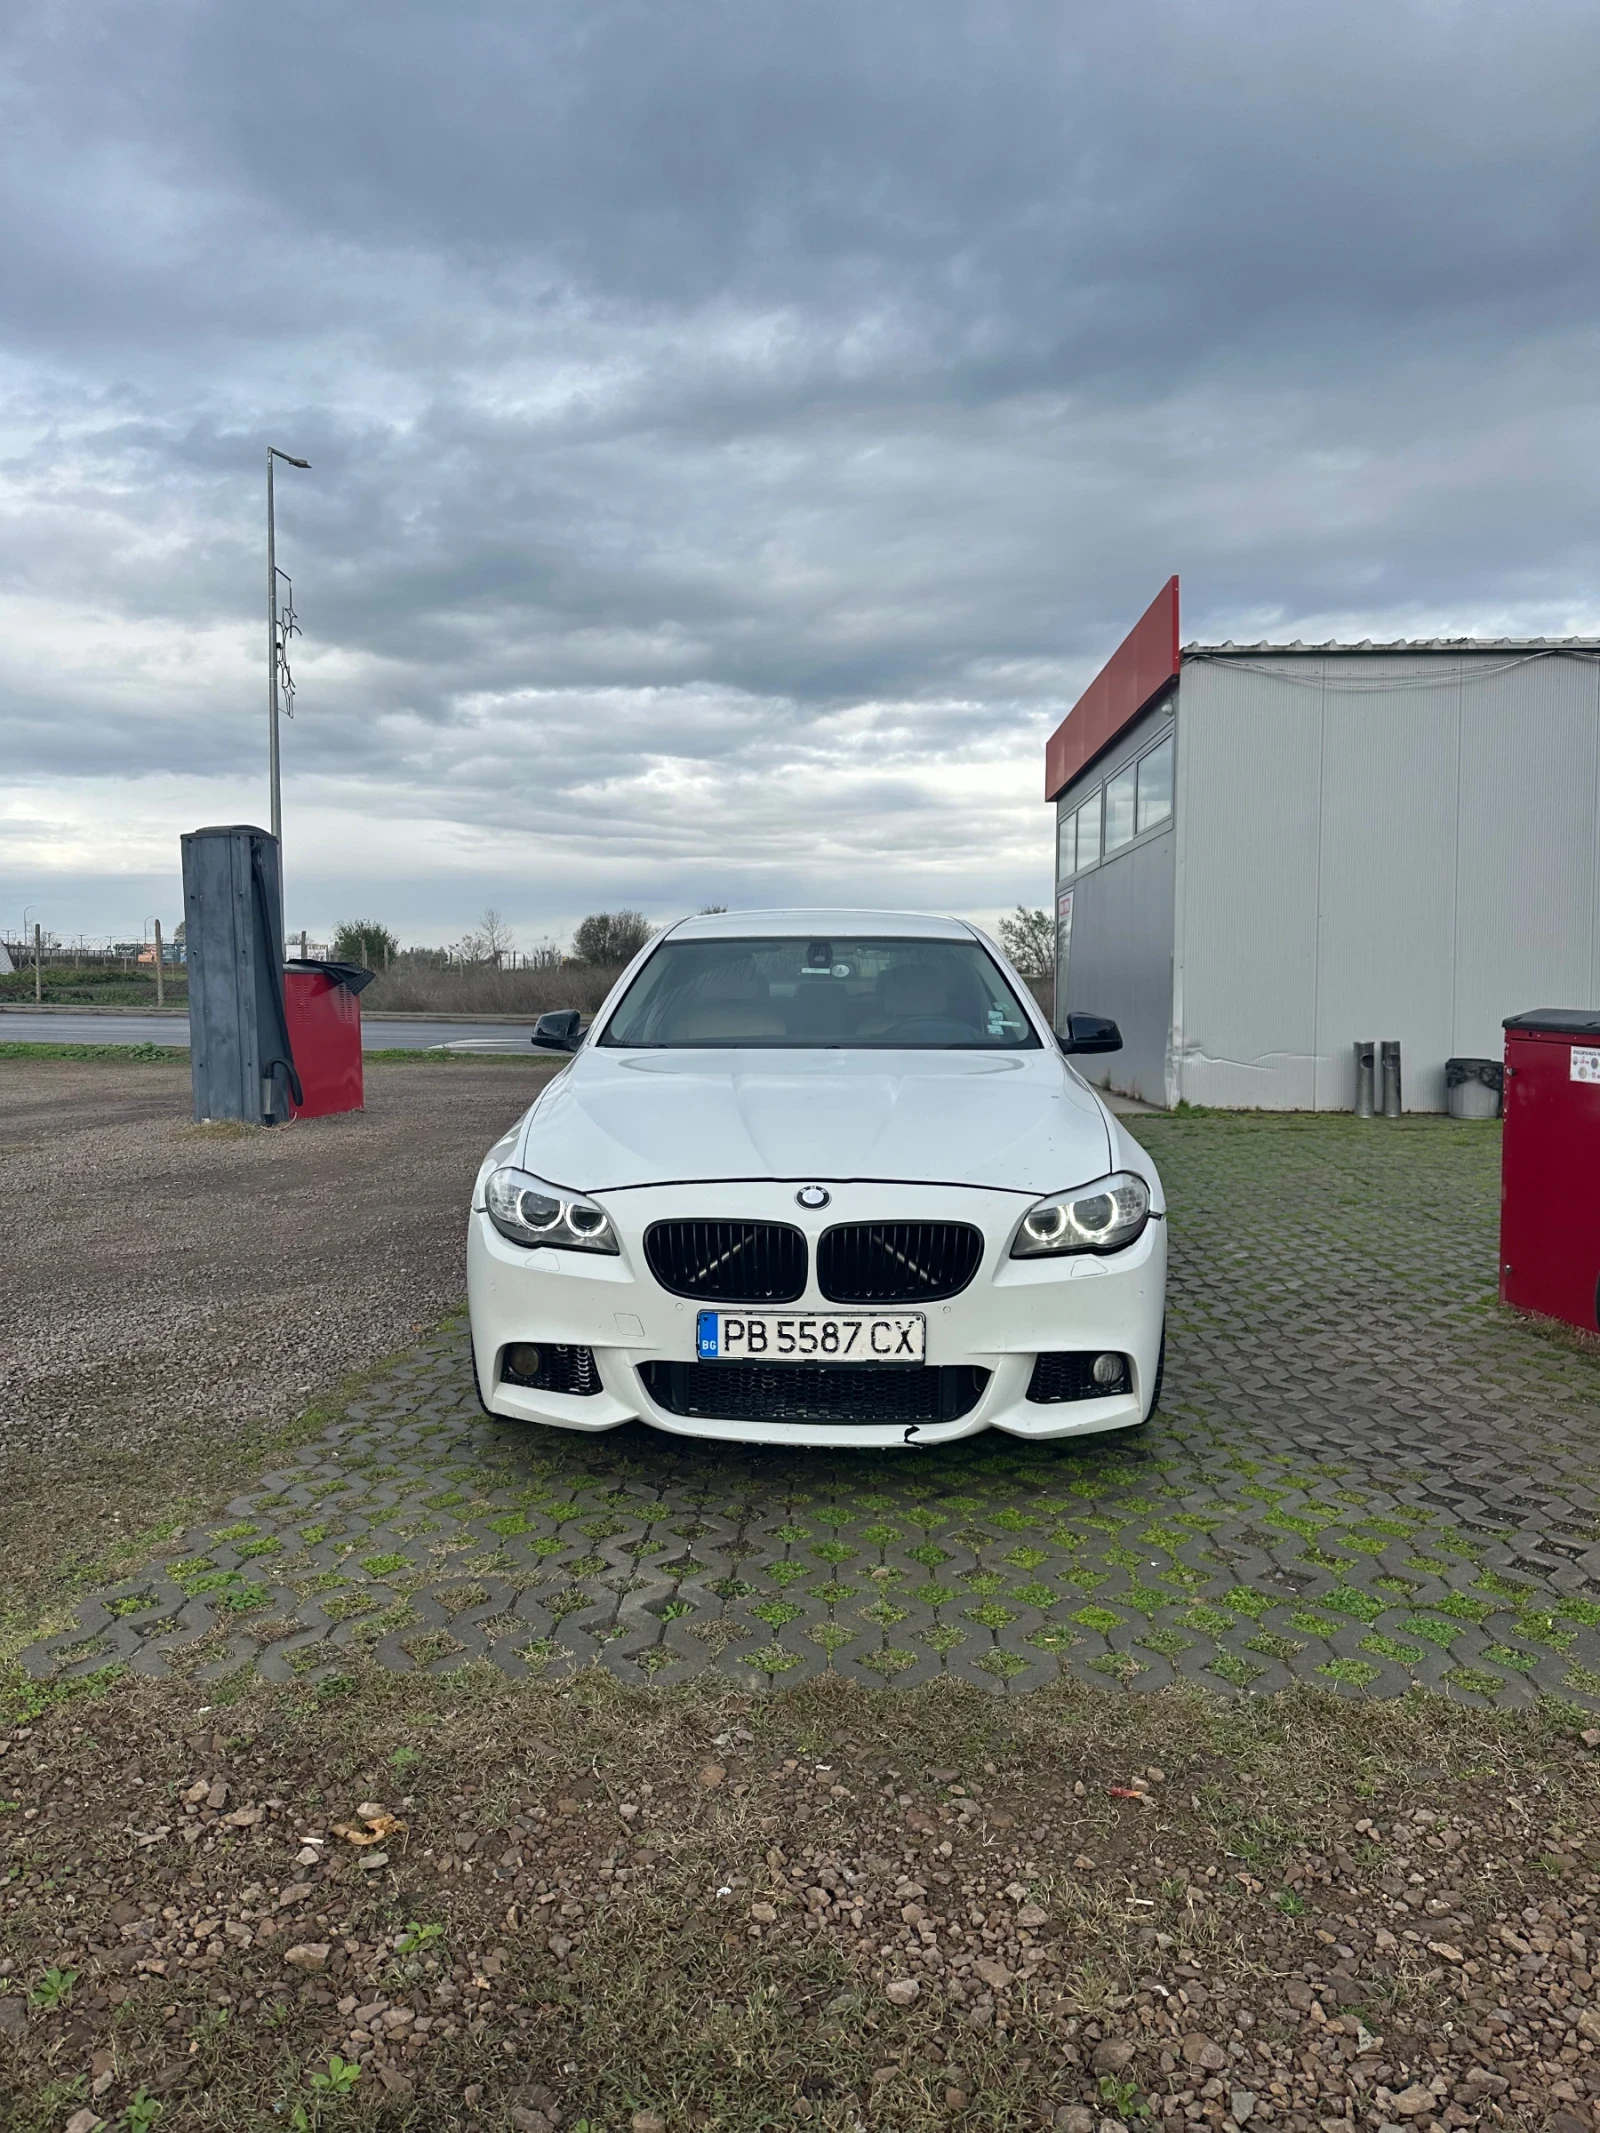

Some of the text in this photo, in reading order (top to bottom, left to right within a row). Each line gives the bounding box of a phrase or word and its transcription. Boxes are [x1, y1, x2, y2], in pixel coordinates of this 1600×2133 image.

[702, 1340, 717, 1350] BG
[724, 1319, 915, 1354] PB 5587 CX
